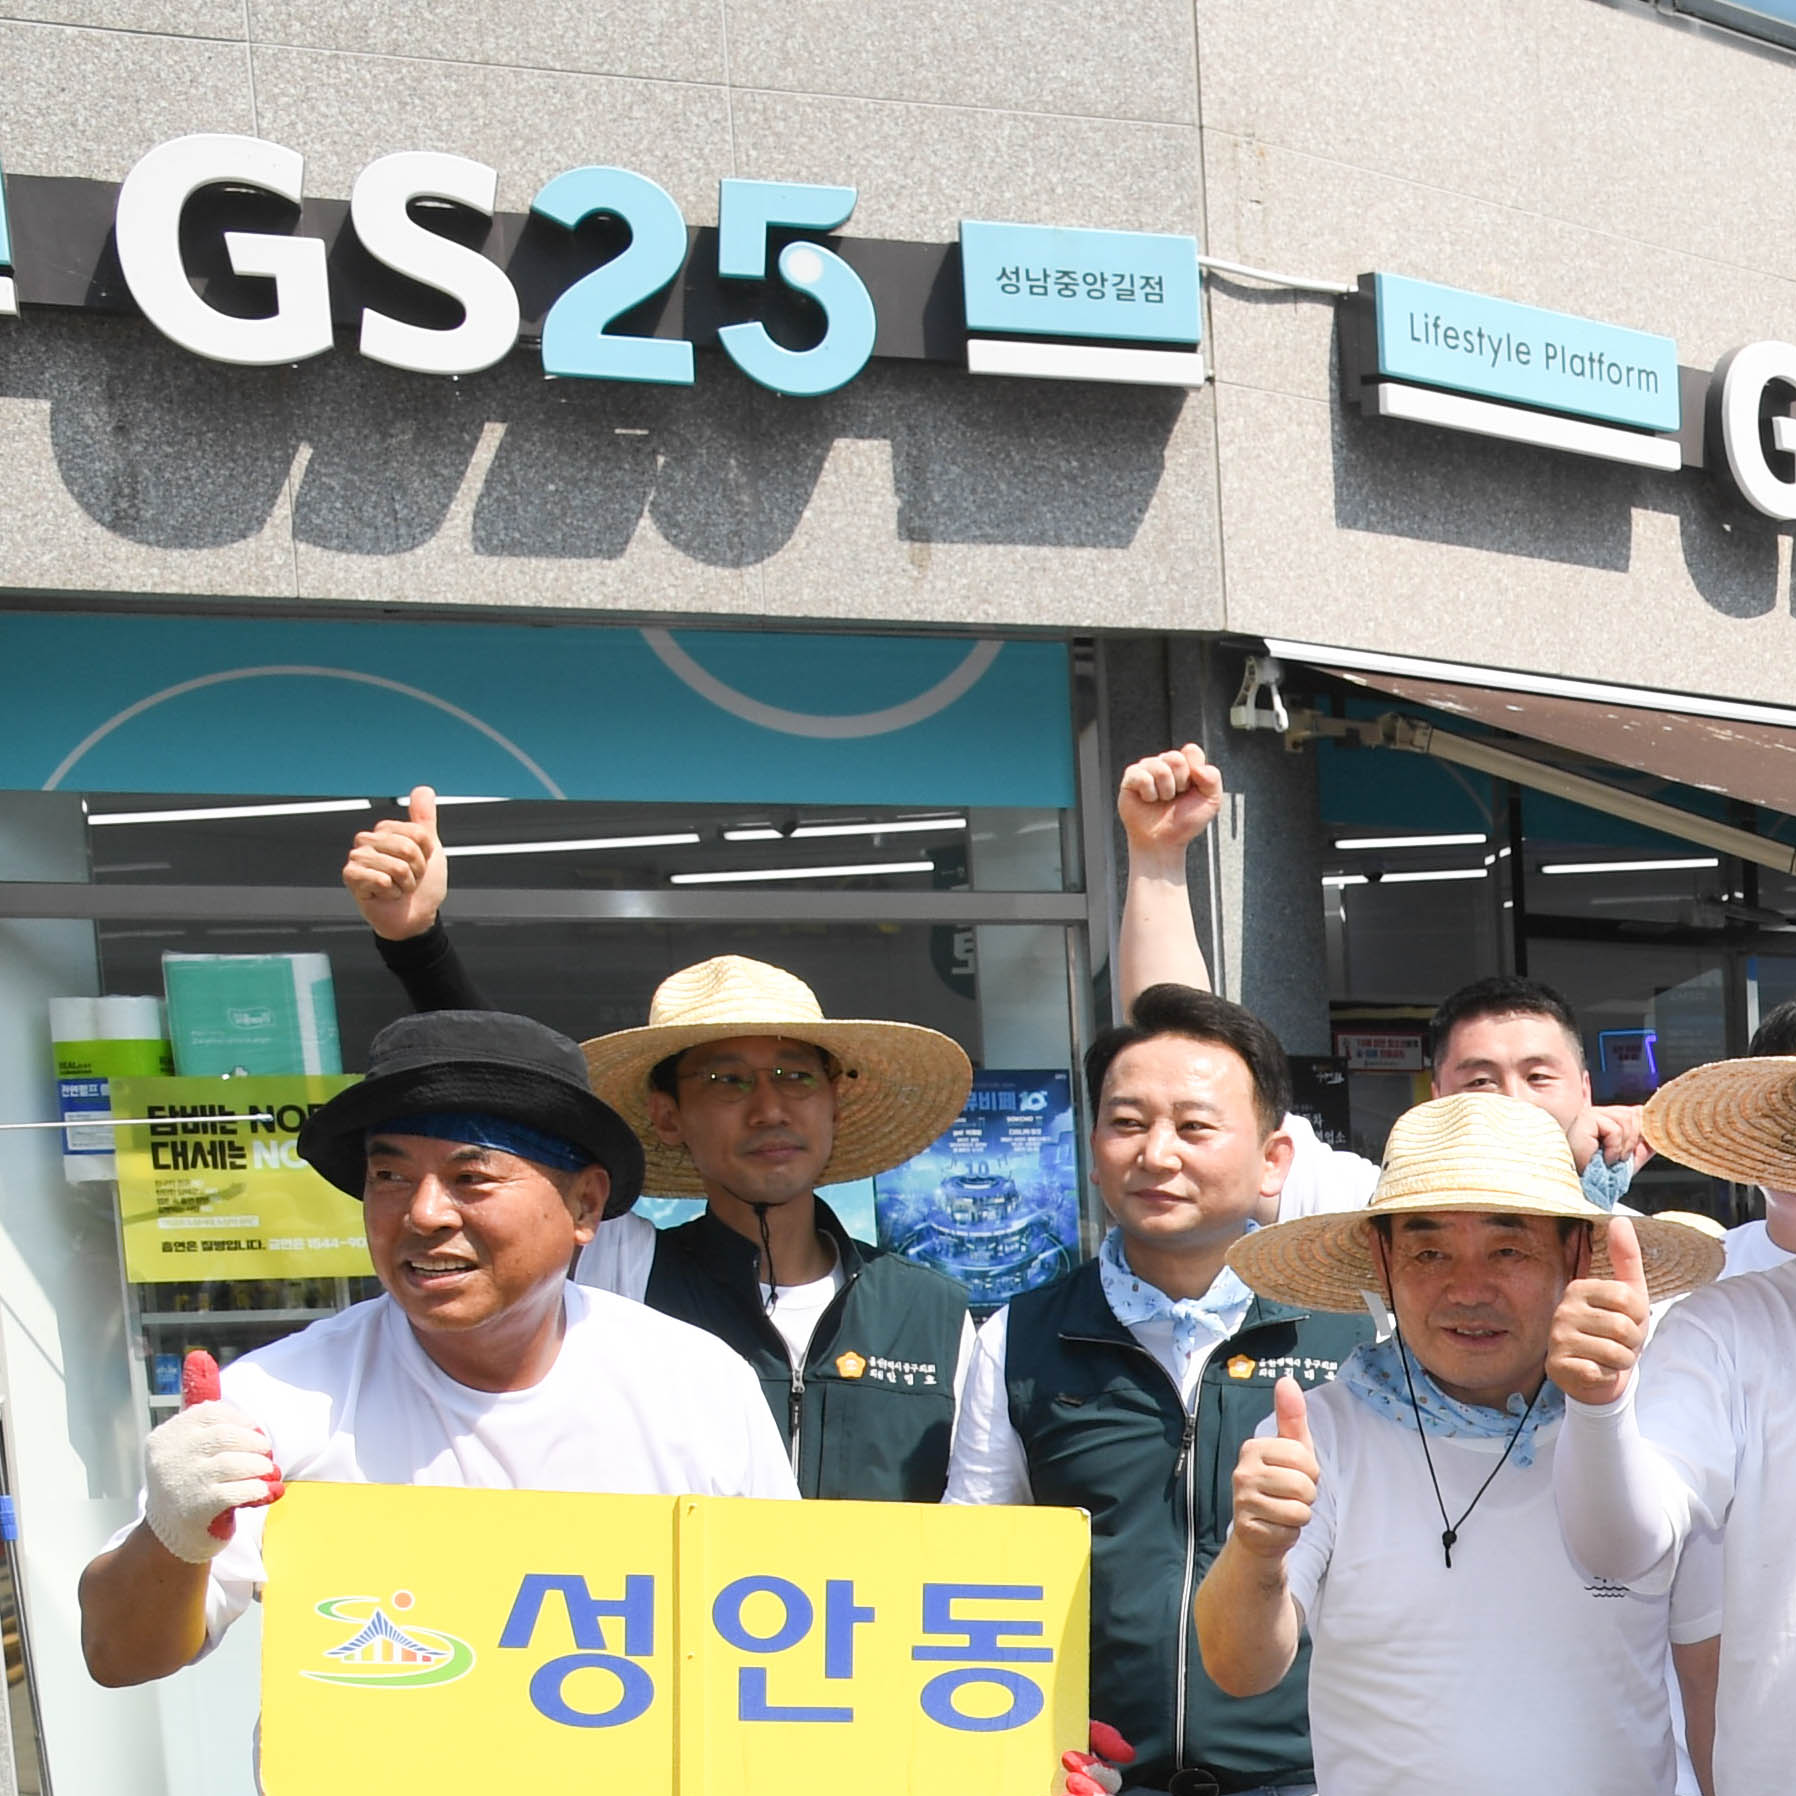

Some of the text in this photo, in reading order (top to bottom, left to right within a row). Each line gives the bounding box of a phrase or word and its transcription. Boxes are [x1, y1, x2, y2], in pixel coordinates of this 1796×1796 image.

[115, 131, 877, 396] GS25
[993, 262, 1166, 305] 성남중앙길점
[1408, 311, 1660, 394] Lifestyle Platform
[152, 1140, 247, 1170] 대세는
[497, 1573, 1054, 1732] 성안동
